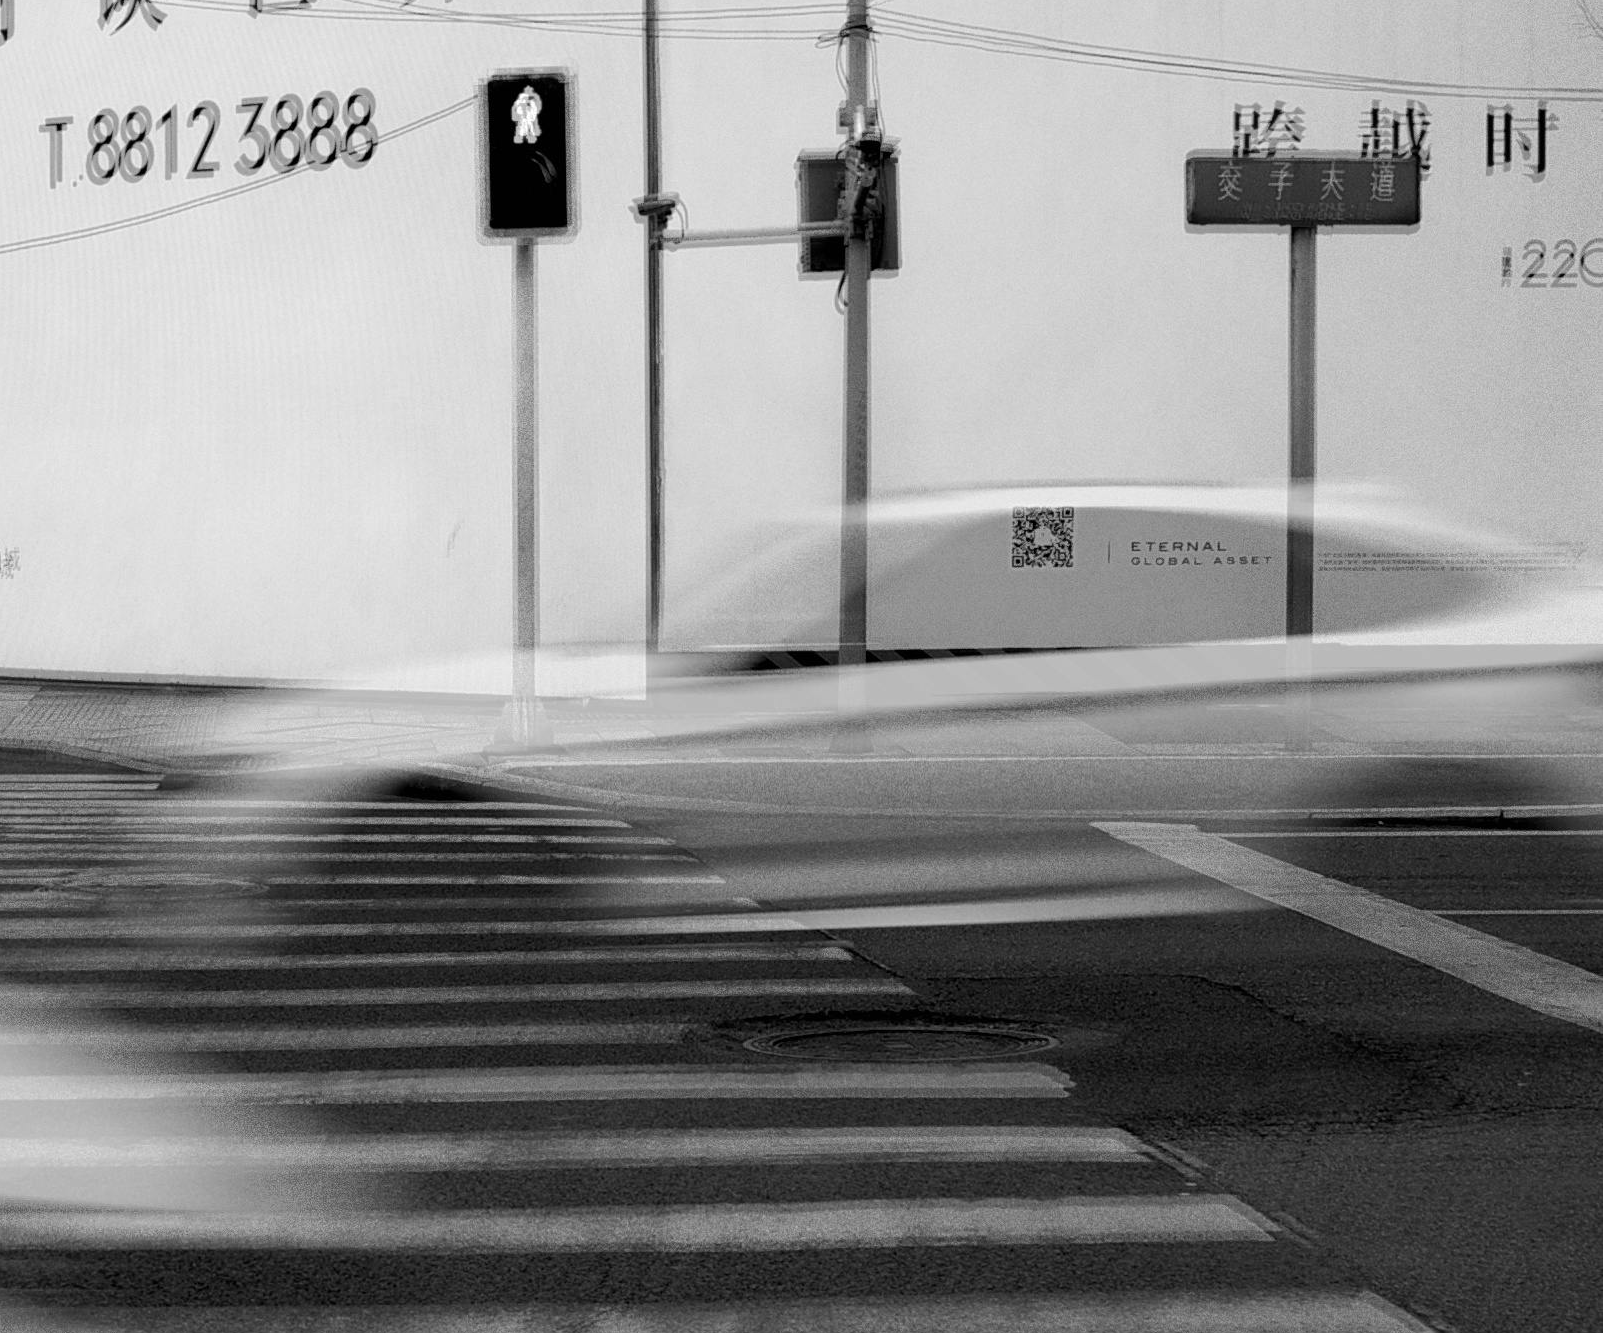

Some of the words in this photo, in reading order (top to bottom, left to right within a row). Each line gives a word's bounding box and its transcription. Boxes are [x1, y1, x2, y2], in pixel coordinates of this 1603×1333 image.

[234, 87, 379, 175] 3888
[1217, 159, 1396, 202] 交子大道
[1131, 541, 1227, 552] ETERNAL
[1131, 556, 1203, 566] GLOBAL
[1213, 555, 1272, 566] ASSET
